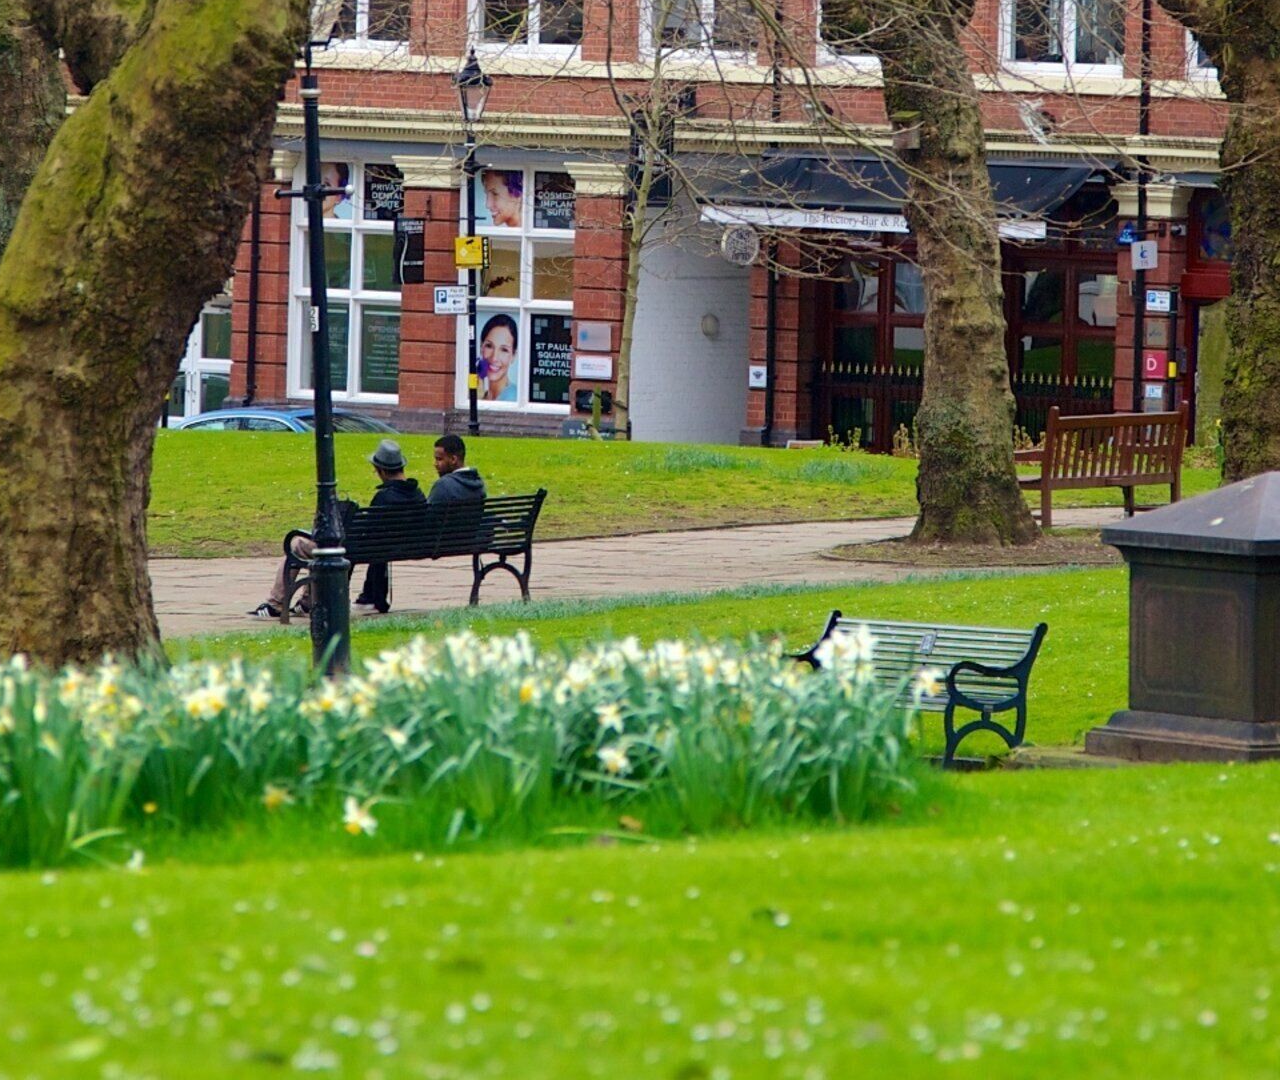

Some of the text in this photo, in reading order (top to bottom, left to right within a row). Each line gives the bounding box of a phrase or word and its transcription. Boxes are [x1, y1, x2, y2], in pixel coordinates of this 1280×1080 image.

[371, 192, 404, 200] DENTAL
[538, 191, 576, 200] COSMET
[546, 208, 571, 216] SUITE
[823, 214, 858, 227] Rectory
[862, 216, 877, 226] Bar
[881, 216, 889, 227] &
[535, 342, 575, 352] ST PAULS
[537, 351, 572, 360] SQUARE
[538, 360, 572, 368] DENTAL
[1147, 357, 1158, 371] D
[533, 368, 571, 377] PRACTIC
